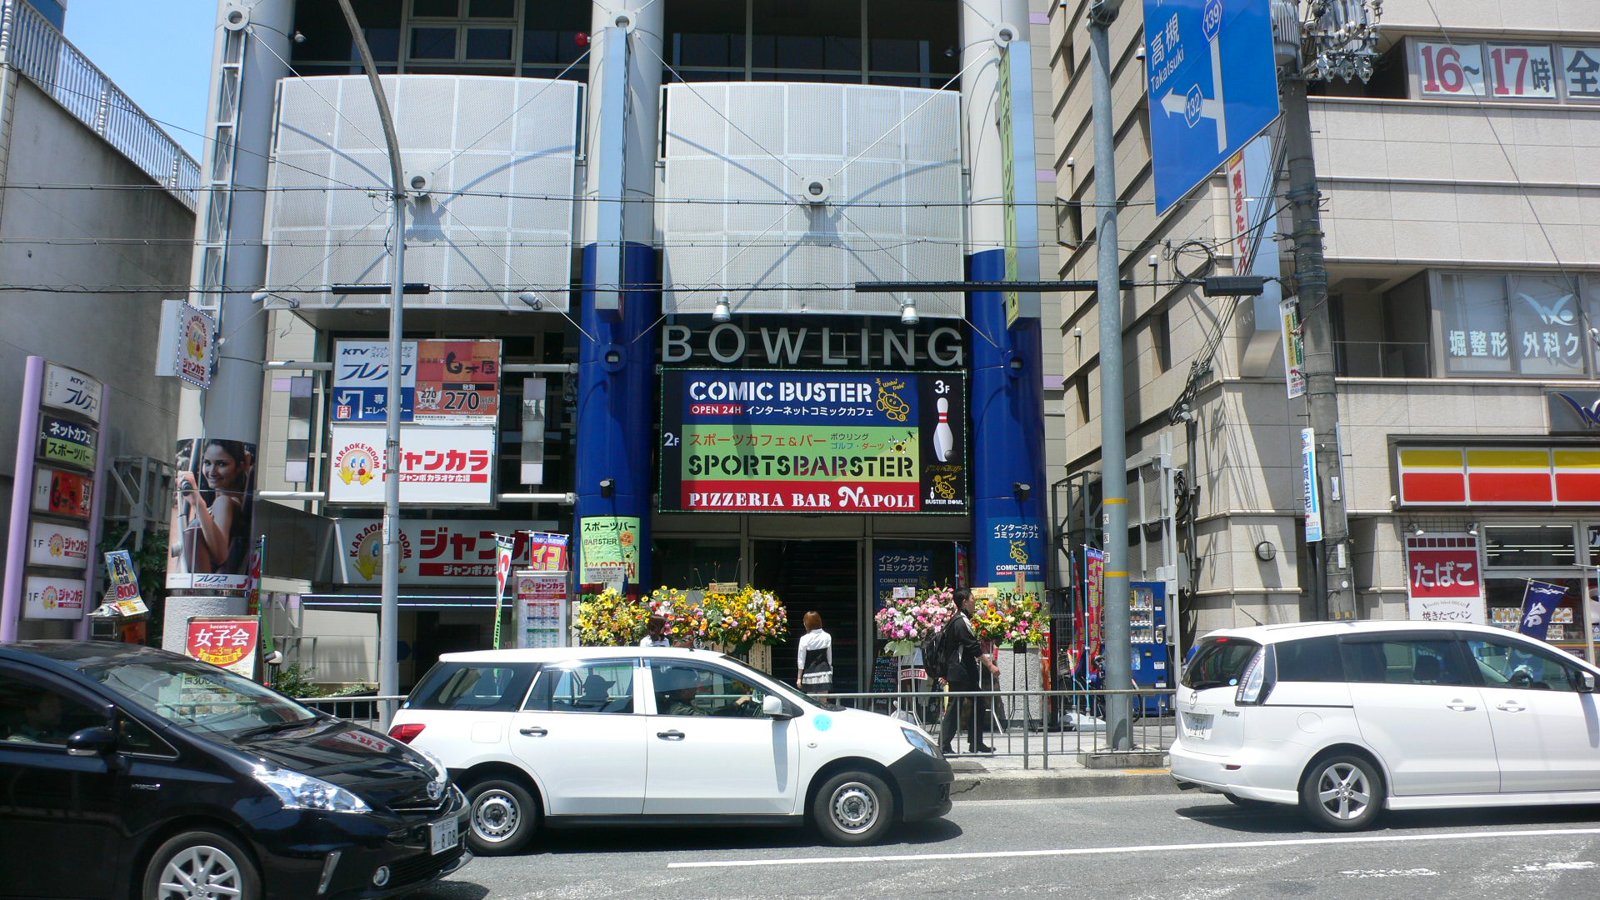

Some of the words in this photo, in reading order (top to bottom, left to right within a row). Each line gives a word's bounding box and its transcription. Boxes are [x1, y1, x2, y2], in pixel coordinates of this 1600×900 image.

[1204, 4, 1219, 32] 139
[1151, 12, 1180, 71] 高槻
[1151, 44, 1184, 93] Takatsuki
[1187, 93, 1200, 120] 132
[342, 348, 371, 356] KTV
[661, 324, 964, 366] BOWLING
[183, 358, 206, 376] ジャンカラ
[70, 376, 85, 386] KTV
[934, 380, 951, 394] 3F
[421, 391, 437, 399] 270
[689, 381, 774, 402] COMIC
[779, 382, 872, 403] BUSTER
[444, 391, 480, 410] 270
[691, 405, 719, 414] OPEN
[722, 406, 742, 414] 24H
[746, 405, 874, 417] インターネットコミックカフェ
[50, 421, 91, 445] ネットカフェ
[663, 432, 680, 447] 2F
[689, 433, 827, 447] スポーツカフェ&バー
[48, 442, 91, 461] スポーツバー
[688, 454, 913, 477] SPORTSBARSTER
[38, 485, 48, 495] 1F
[688, 492, 785, 507] PIZZERIA
[791, 493, 831, 507] BAR
[837, 486, 915, 508] NAPOLI
[584, 522, 637, 532] スポーツバー
[994, 531, 1039, 539] コミックカフェ
[33, 539, 45, 548] 1F
[64, 537, 88, 552] ジャンカラ
[879, 555, 929, 563] インターネット
[879, 564, 929, 572] コミックカフェ
[1413, 561, 1475, 588] たばこ
[117, 583, 137, 598] 800
[535, 582, 565, 590] ジャンカラ
[28, 592, 39, 602] 1F
[58, 588, 83, 602] ジャンカラ
[1422, 610, 1472, 621] 焼きたてパン
[194, 628, 250, 647] 女子会
